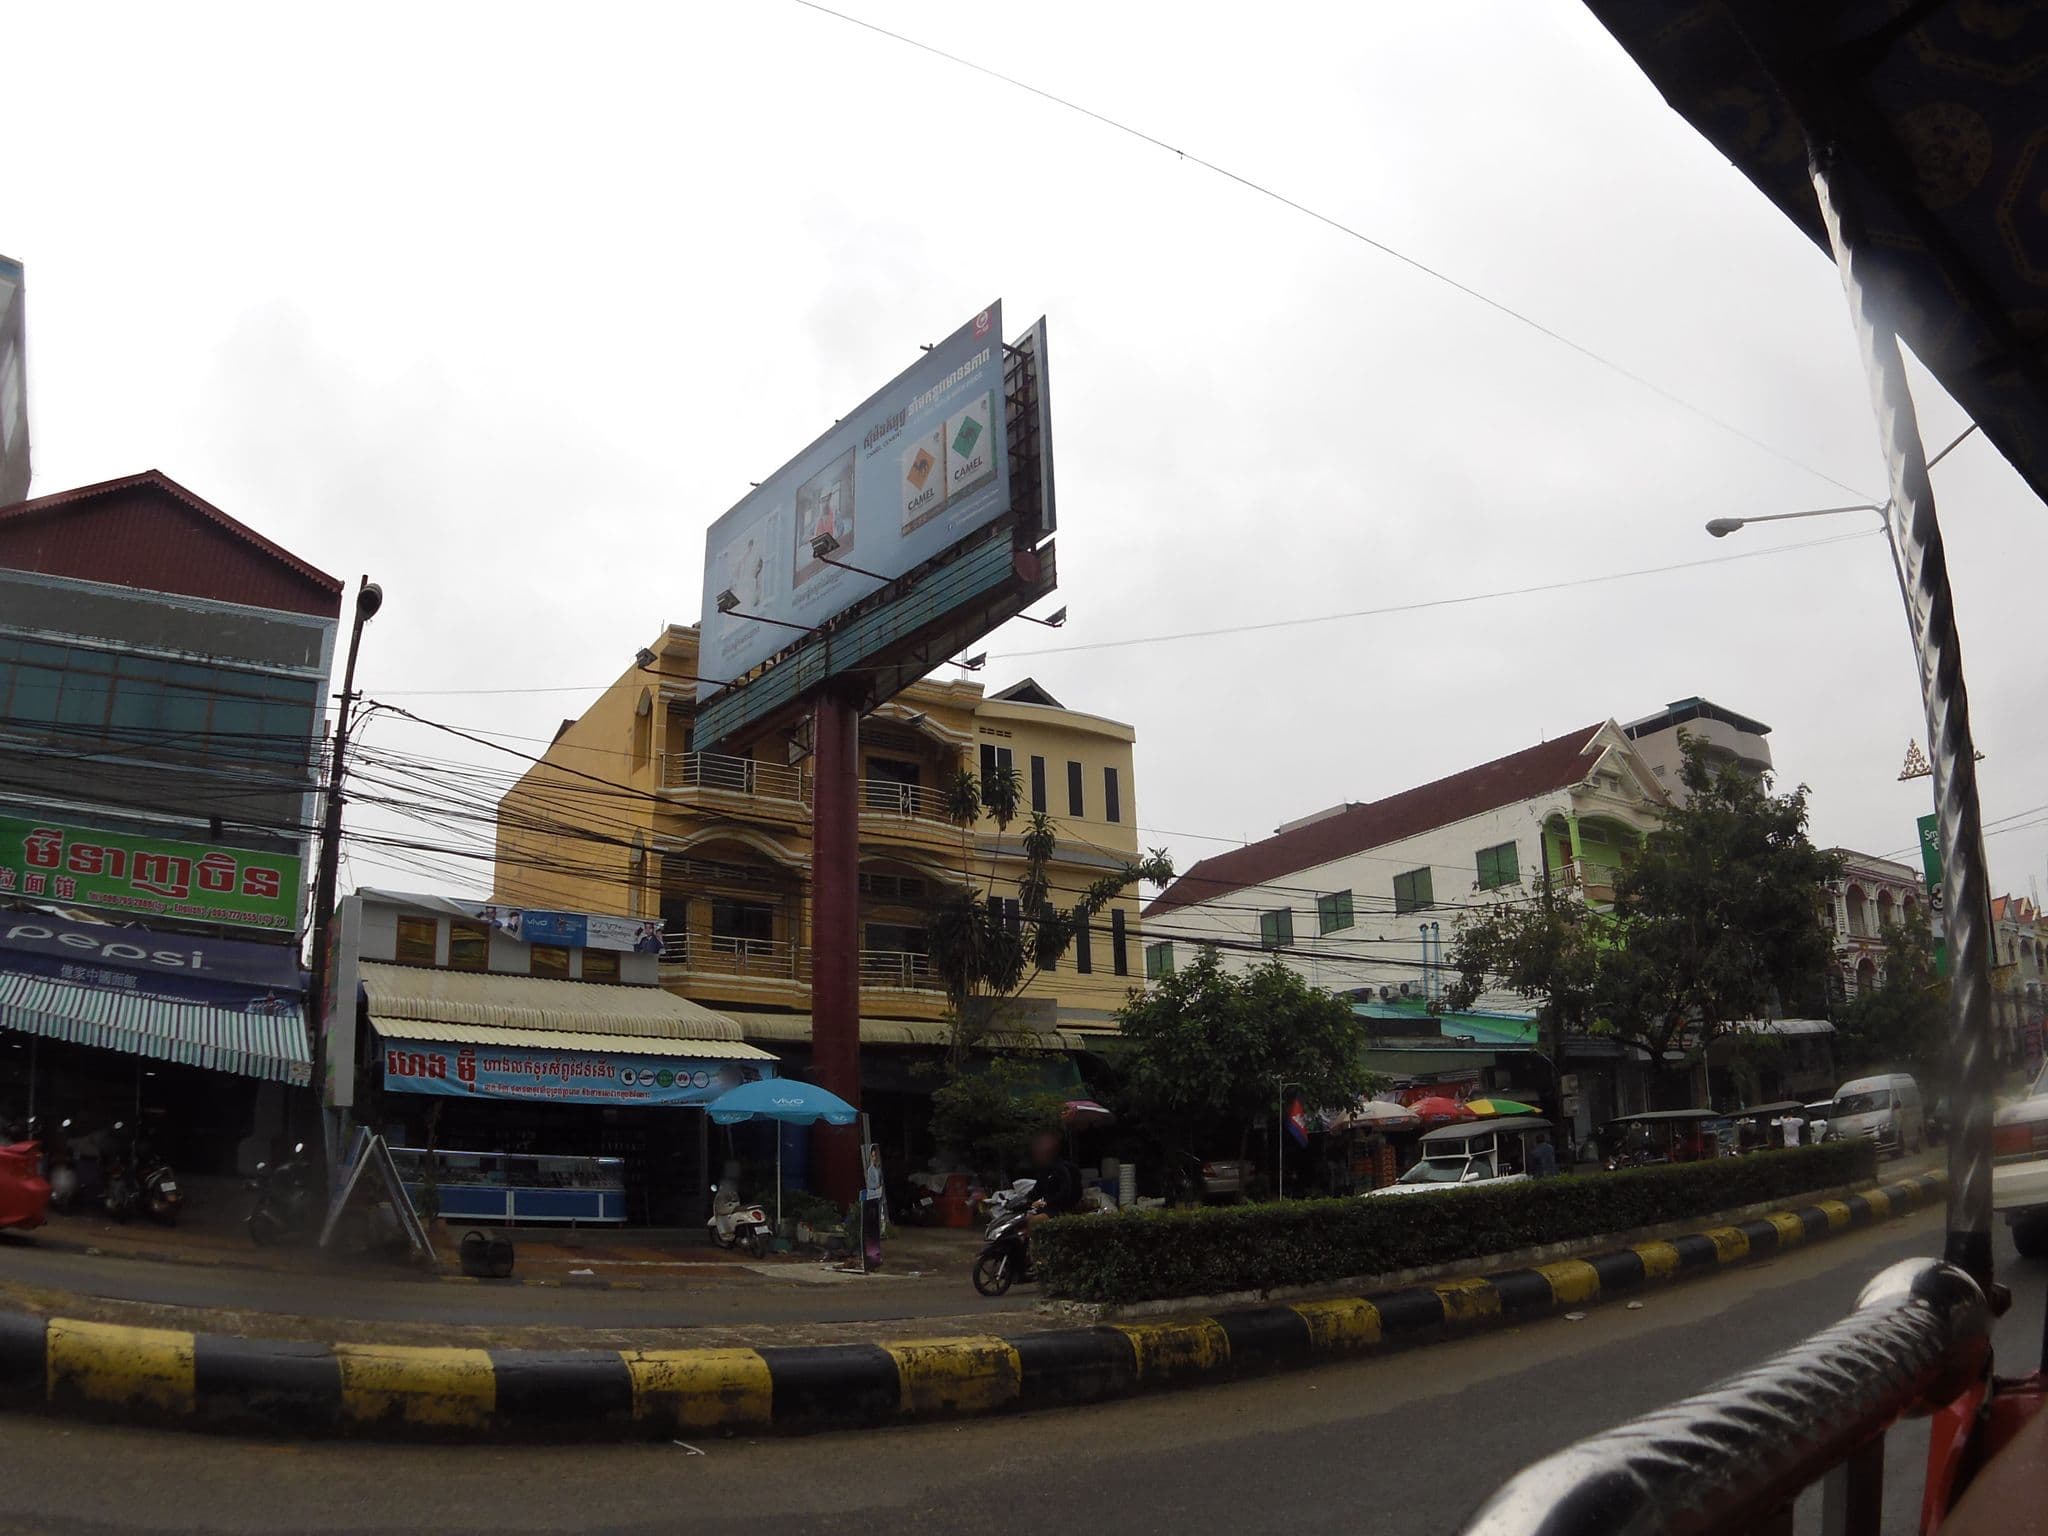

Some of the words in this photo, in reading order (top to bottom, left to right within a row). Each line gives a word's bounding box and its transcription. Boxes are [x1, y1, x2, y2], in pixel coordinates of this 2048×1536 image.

[954, 456, 983, 481] CAMEL
[907, 487, 935, 511] CAMEL
[527, 918, 548, 927] vivo
[6, 923, 205, 970] pepsi
[772, 1098, 804, 1106] vivo
